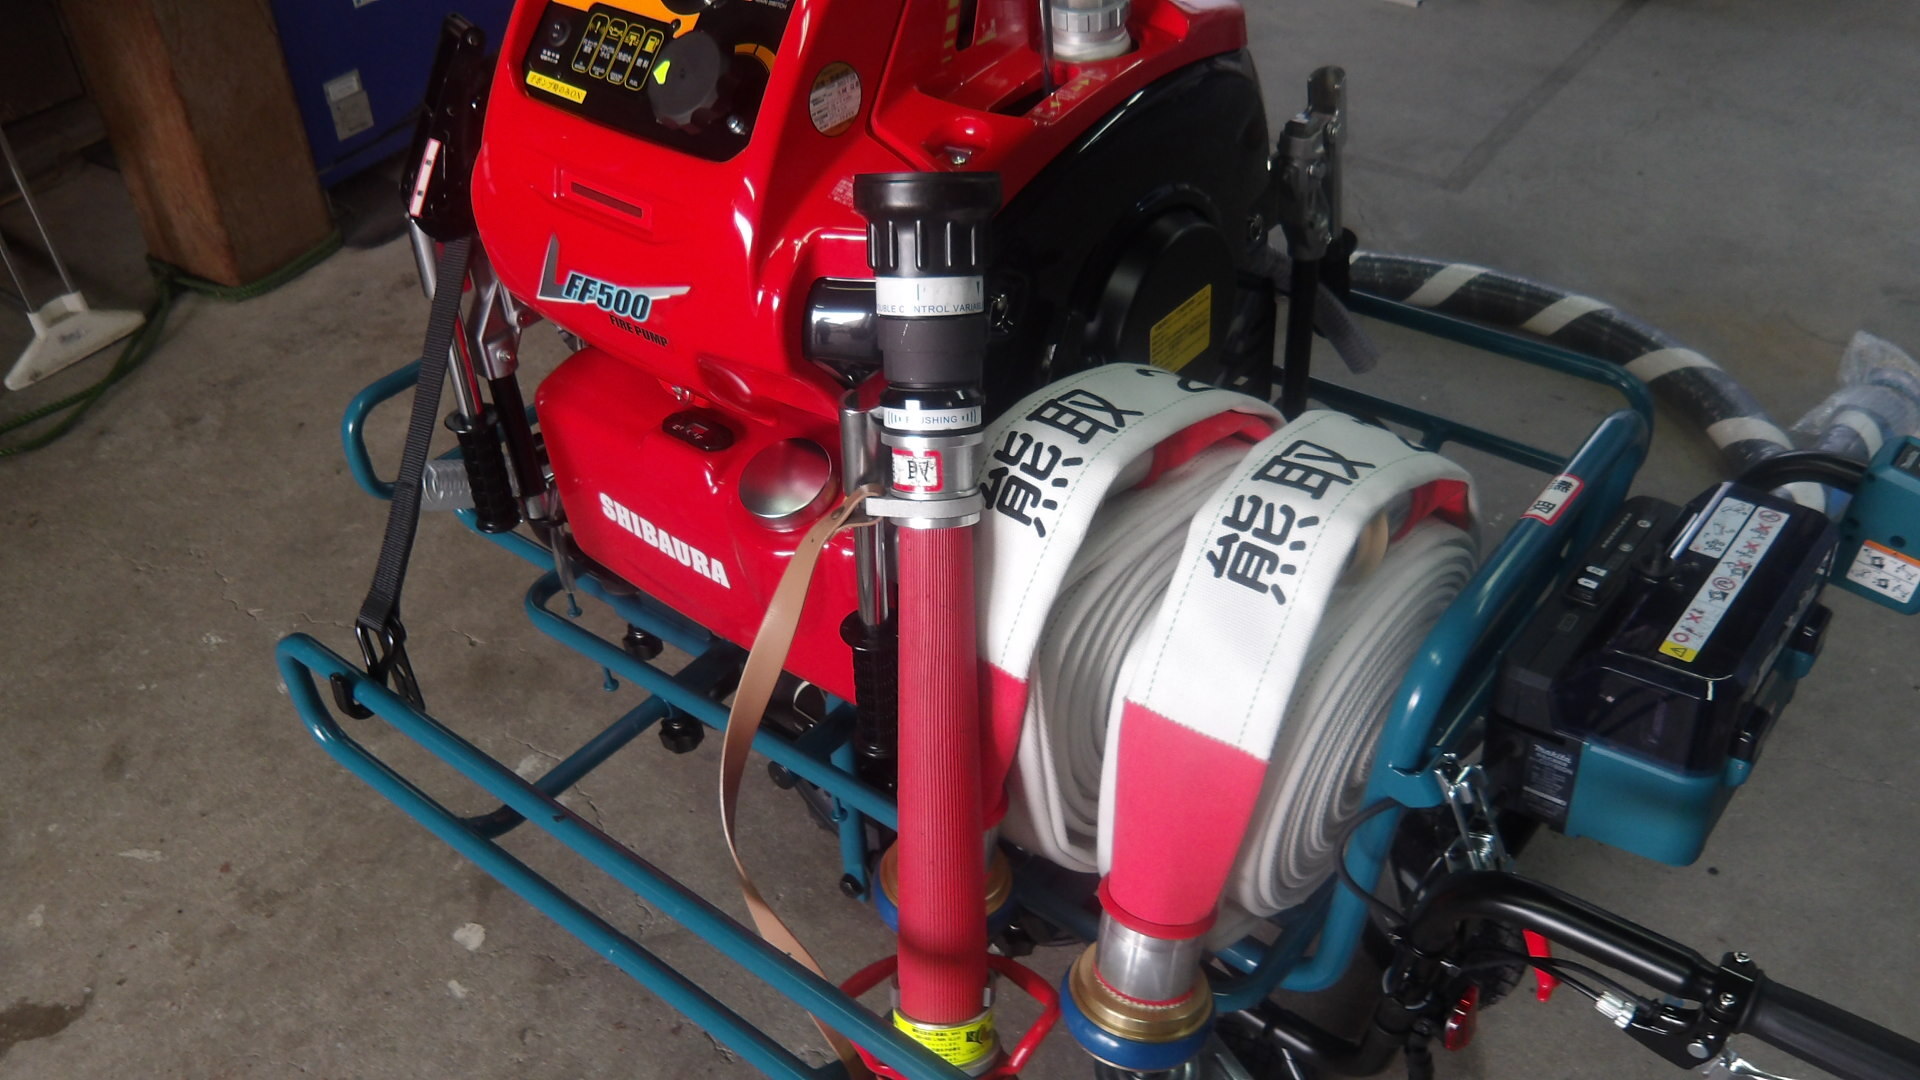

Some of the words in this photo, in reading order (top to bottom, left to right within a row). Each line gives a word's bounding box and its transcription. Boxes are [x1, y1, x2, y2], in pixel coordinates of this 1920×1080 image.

[608, 314, 634, 334] FIRE
[634, 325, 669, 348] PUMP
[979, 388, 1145, 538] 熊取
[1206, 439, 1376, 606] 熊取
[599, 491, 732, 590] SHIBAURA
